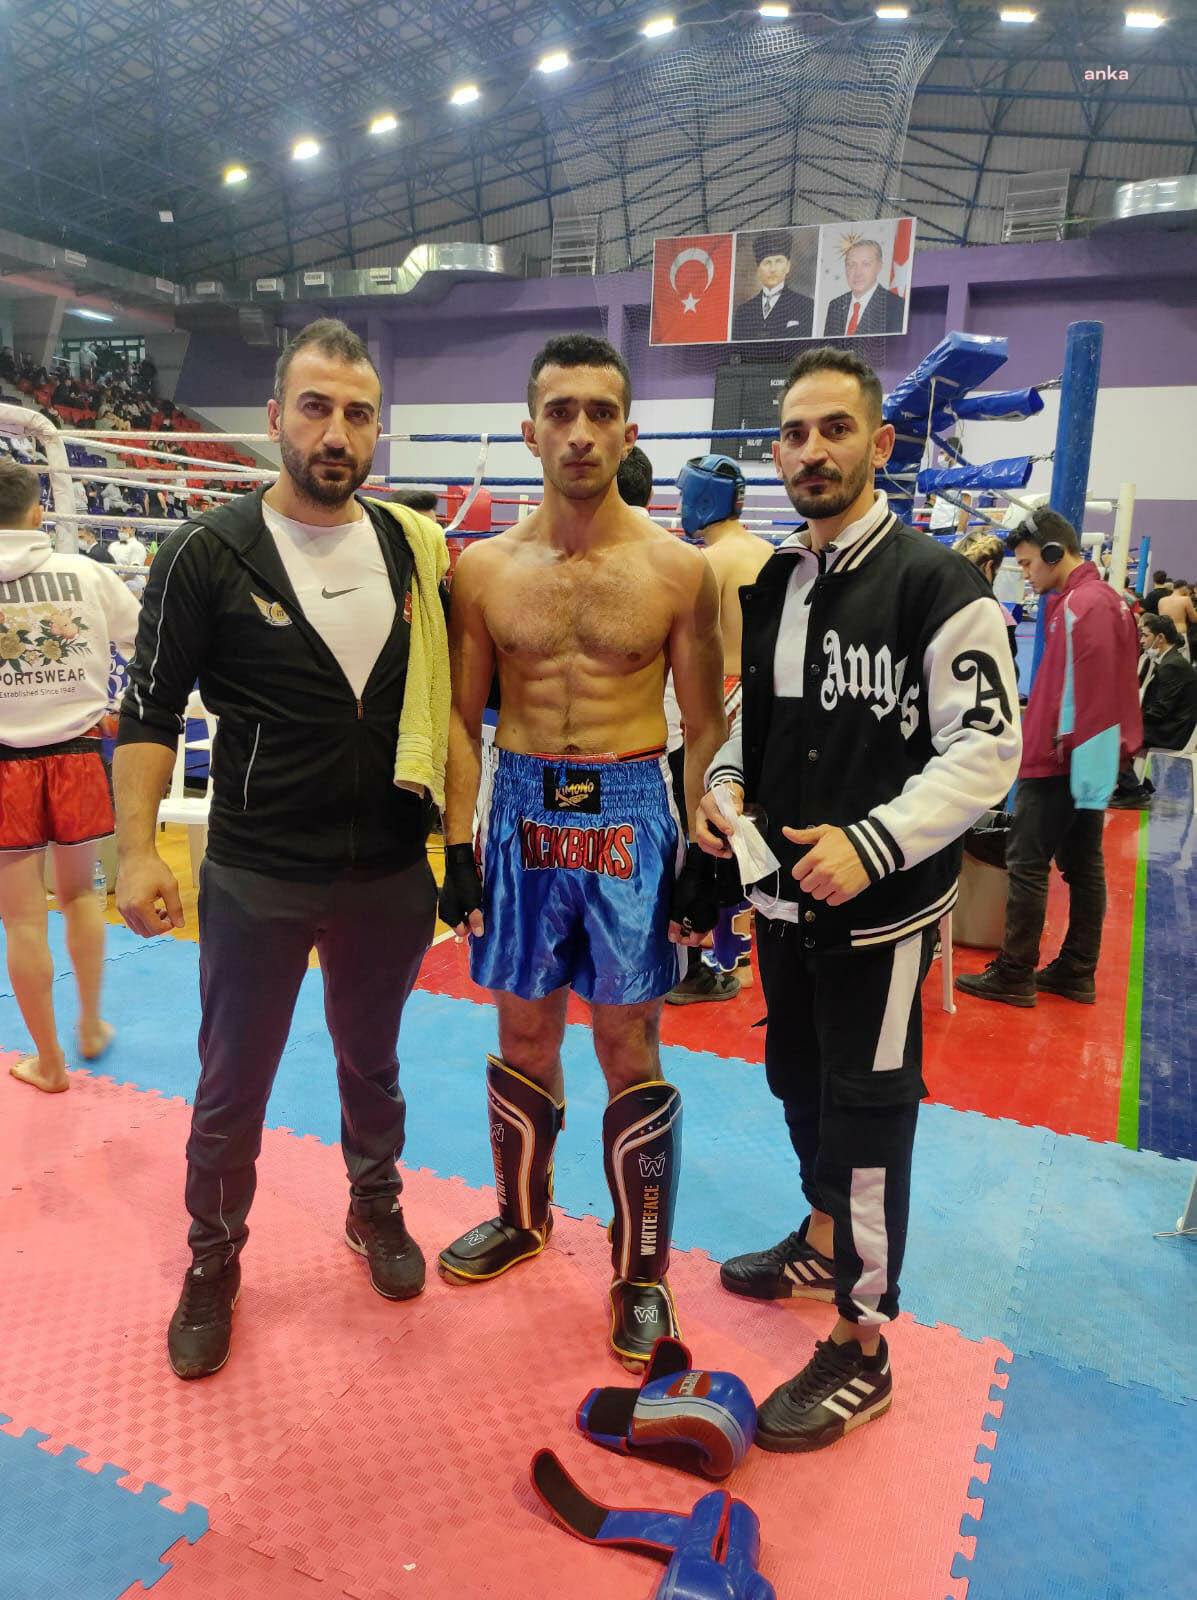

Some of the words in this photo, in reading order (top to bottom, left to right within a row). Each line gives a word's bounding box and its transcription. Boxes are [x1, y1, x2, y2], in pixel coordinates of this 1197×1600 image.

[0, 668, 86, 686] ORTSWEAR
[952, 650, 1013, 736] A
[640, 1184, 660, 1256] WHITEFACE
